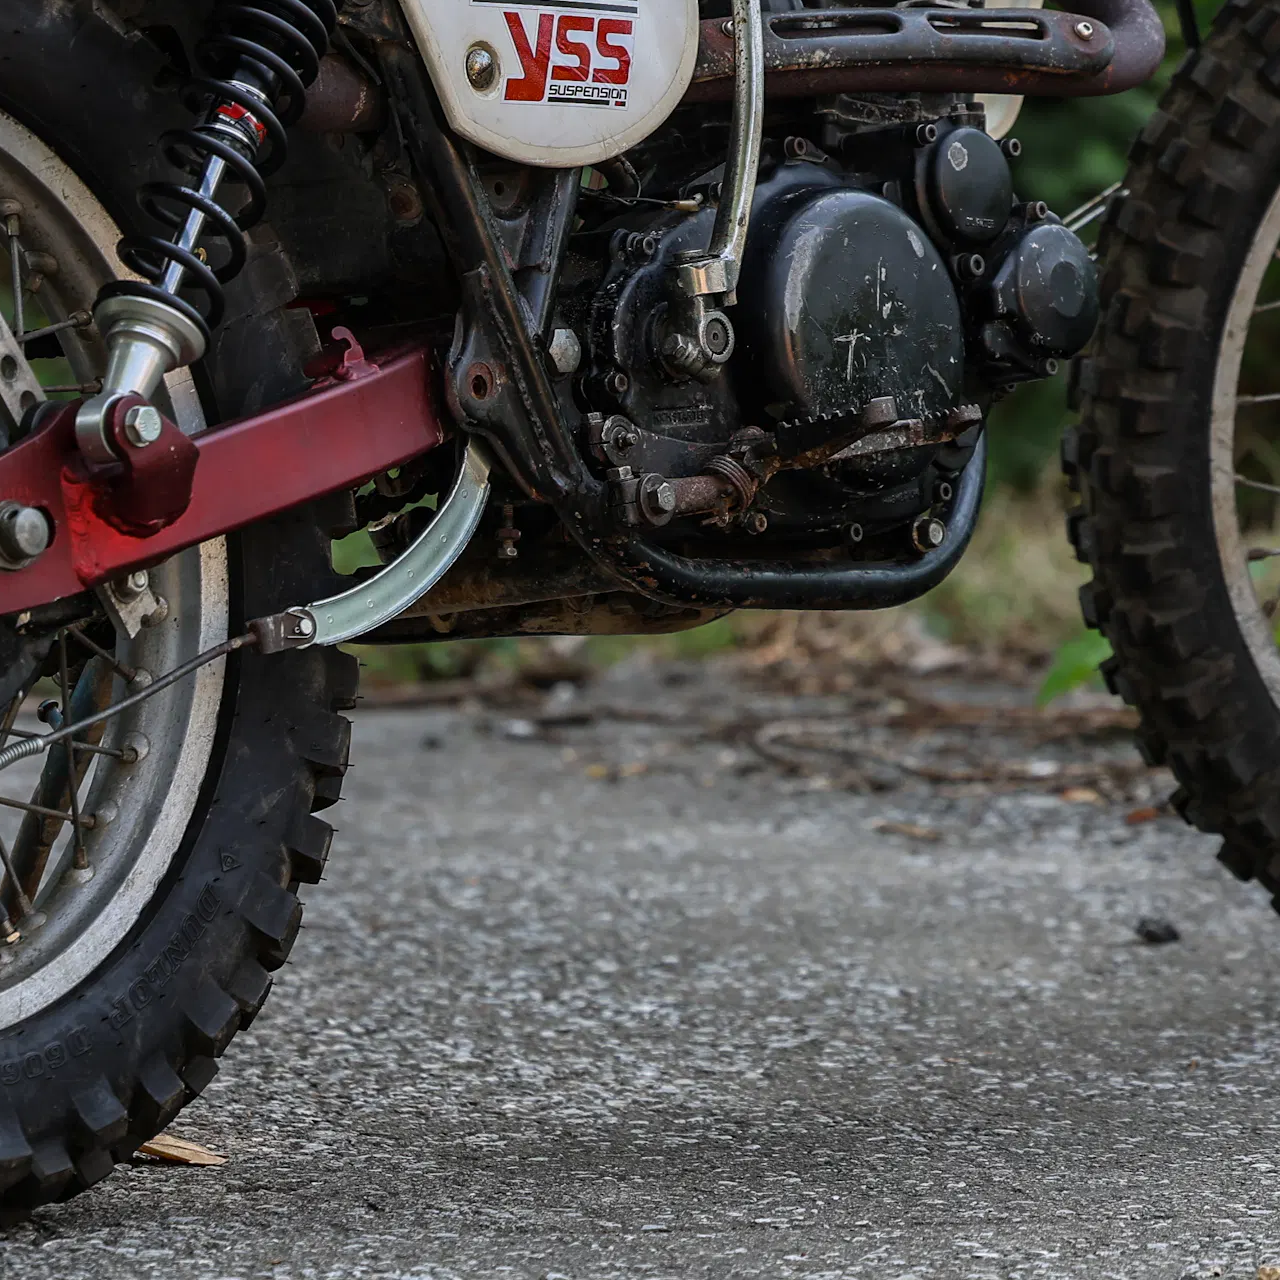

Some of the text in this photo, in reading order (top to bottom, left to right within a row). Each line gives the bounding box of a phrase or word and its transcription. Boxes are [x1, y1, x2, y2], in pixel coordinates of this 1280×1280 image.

[503, 11, 633, 102] YSS
[548, 84, 628, 100] SUSPENSION
[0, 881, 222, 1086] DUNLOP D606
